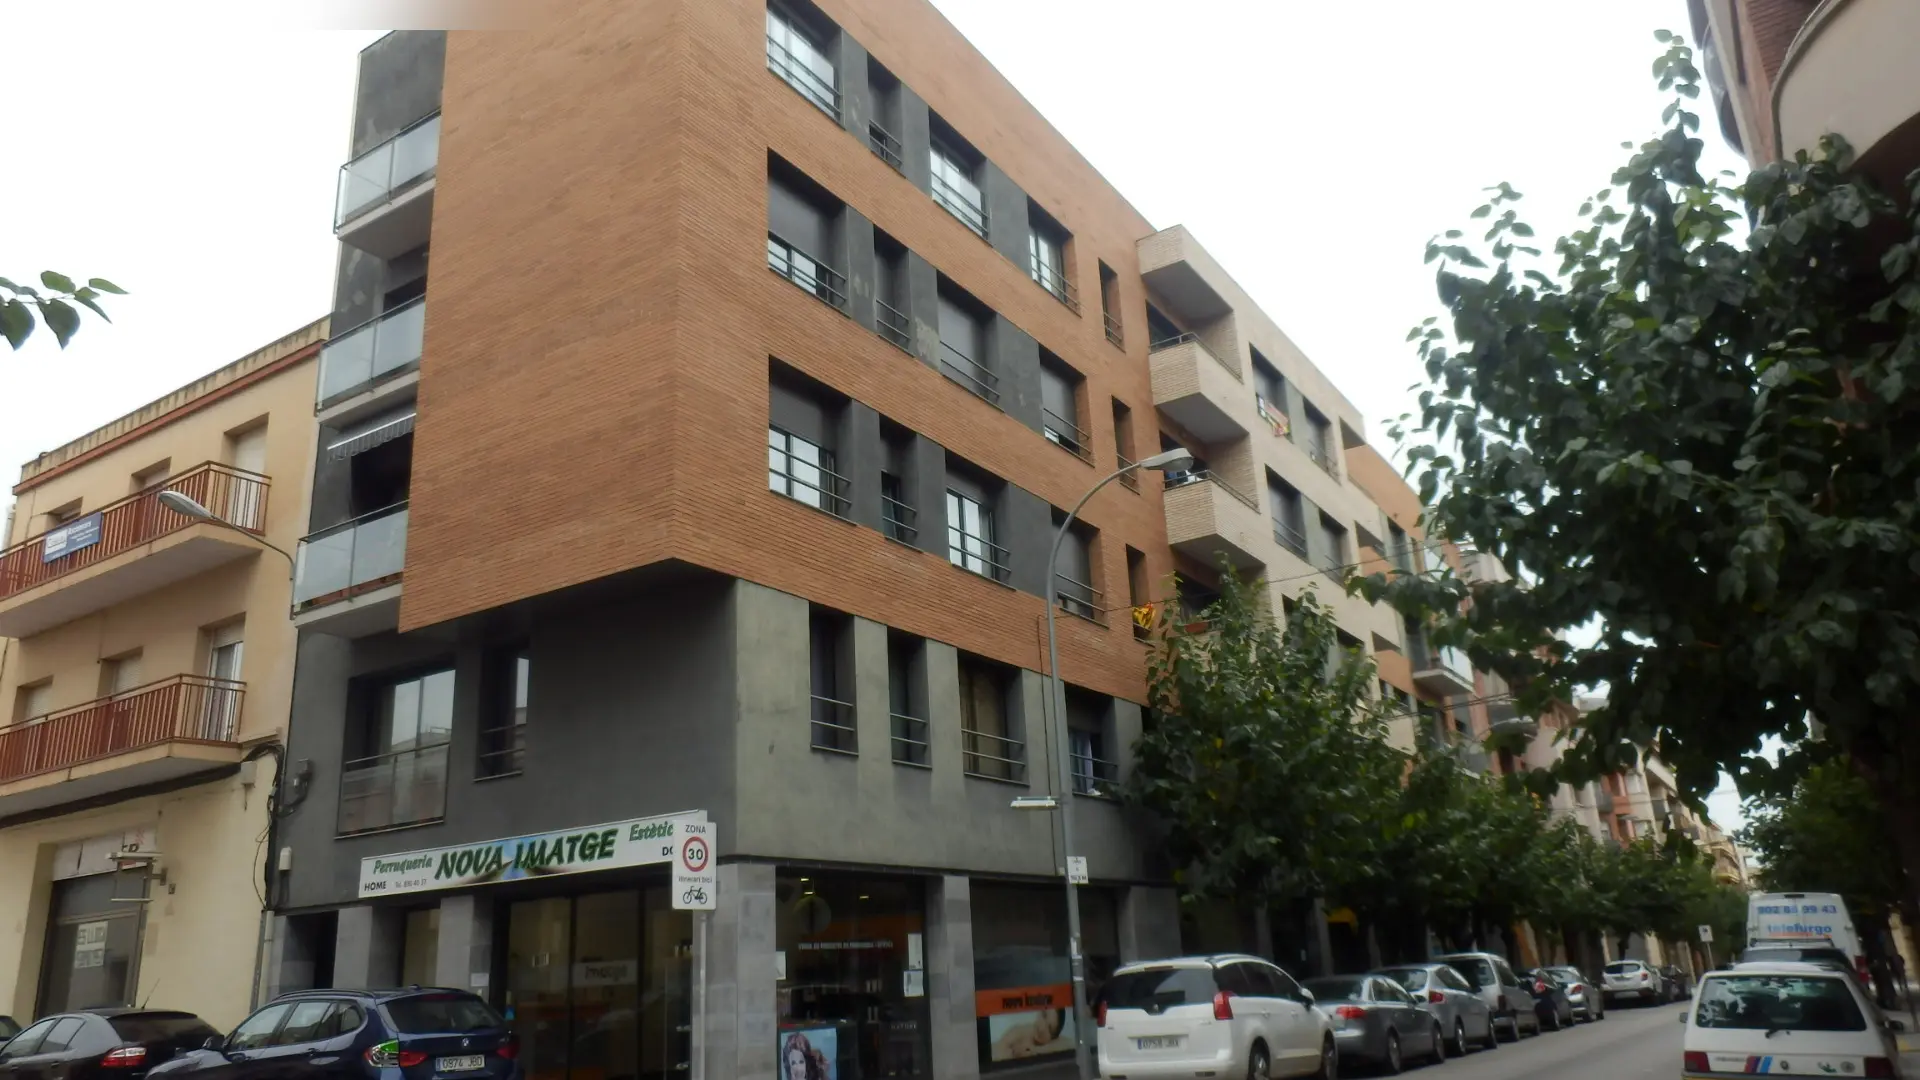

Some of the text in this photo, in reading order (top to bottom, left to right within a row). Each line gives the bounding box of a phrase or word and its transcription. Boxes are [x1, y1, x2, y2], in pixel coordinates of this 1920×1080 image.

[629, 821, 673, 842] Estètic
[685, 824, 706, 834] ZONA
[434, 828, 619, 881] NOVA IMATGE
[688, 848, 704, 861] 30
[373, 854, 433, 875] Perruqueria
[364, 881, 387, 892] HOME
[1768, 923, 1832, 934] telefurgo
